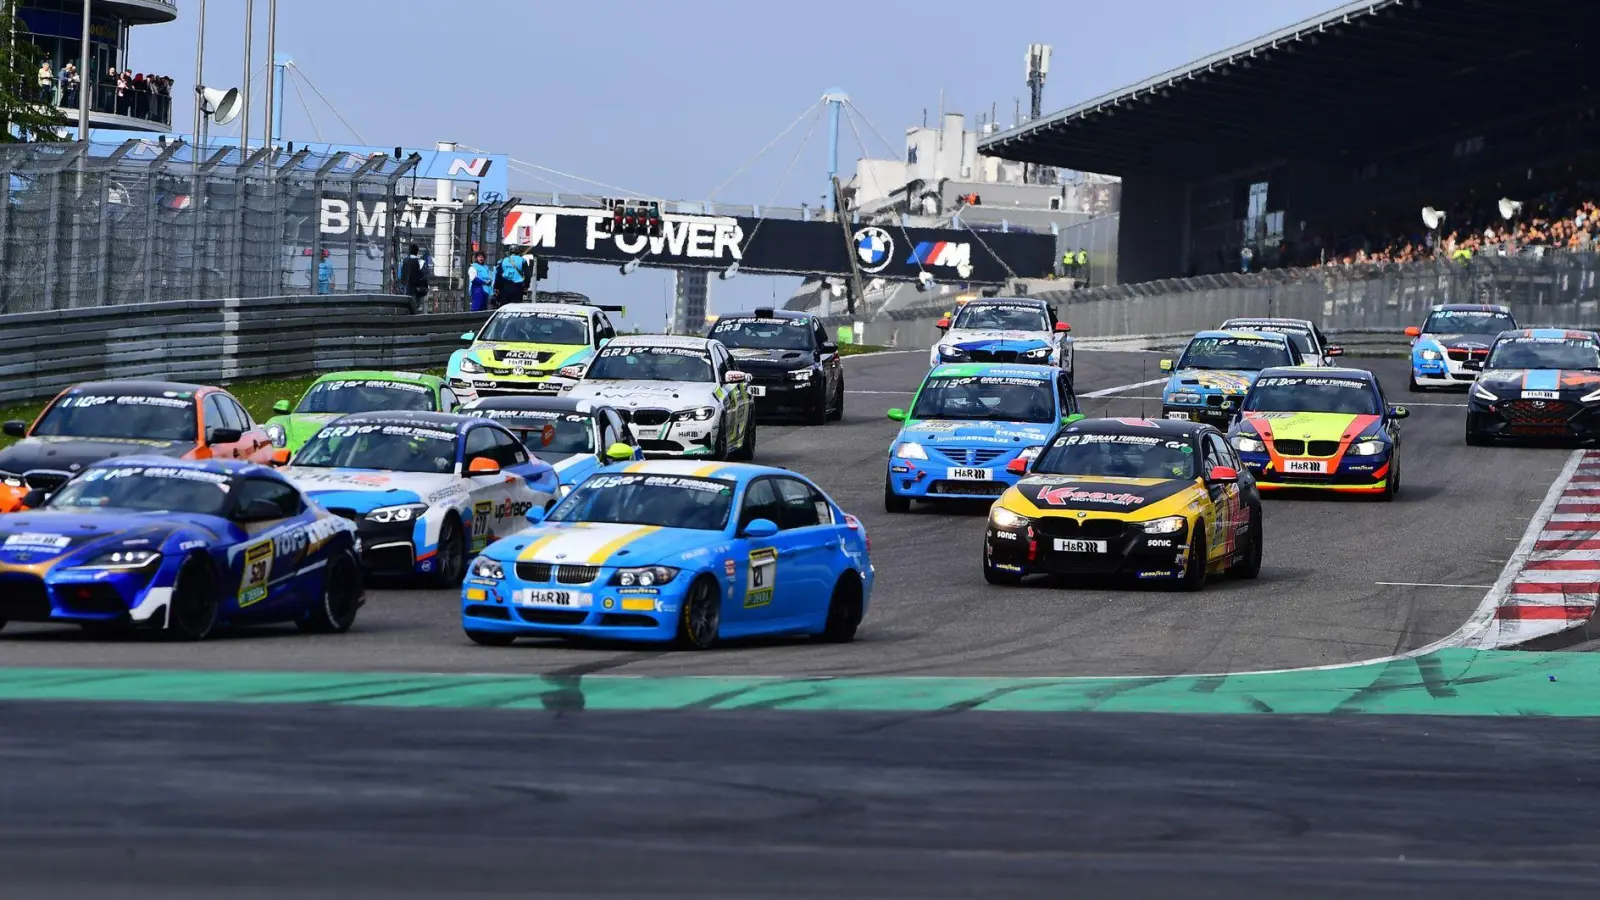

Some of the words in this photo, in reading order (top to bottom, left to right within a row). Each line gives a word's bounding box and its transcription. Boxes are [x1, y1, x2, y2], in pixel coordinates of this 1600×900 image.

[585, 214, 743, 259] POWER
[506, 351, 538, 359] RACING
[1061, 541, 1084, 552] H&R
[530, 591, 555, 604] H&R
